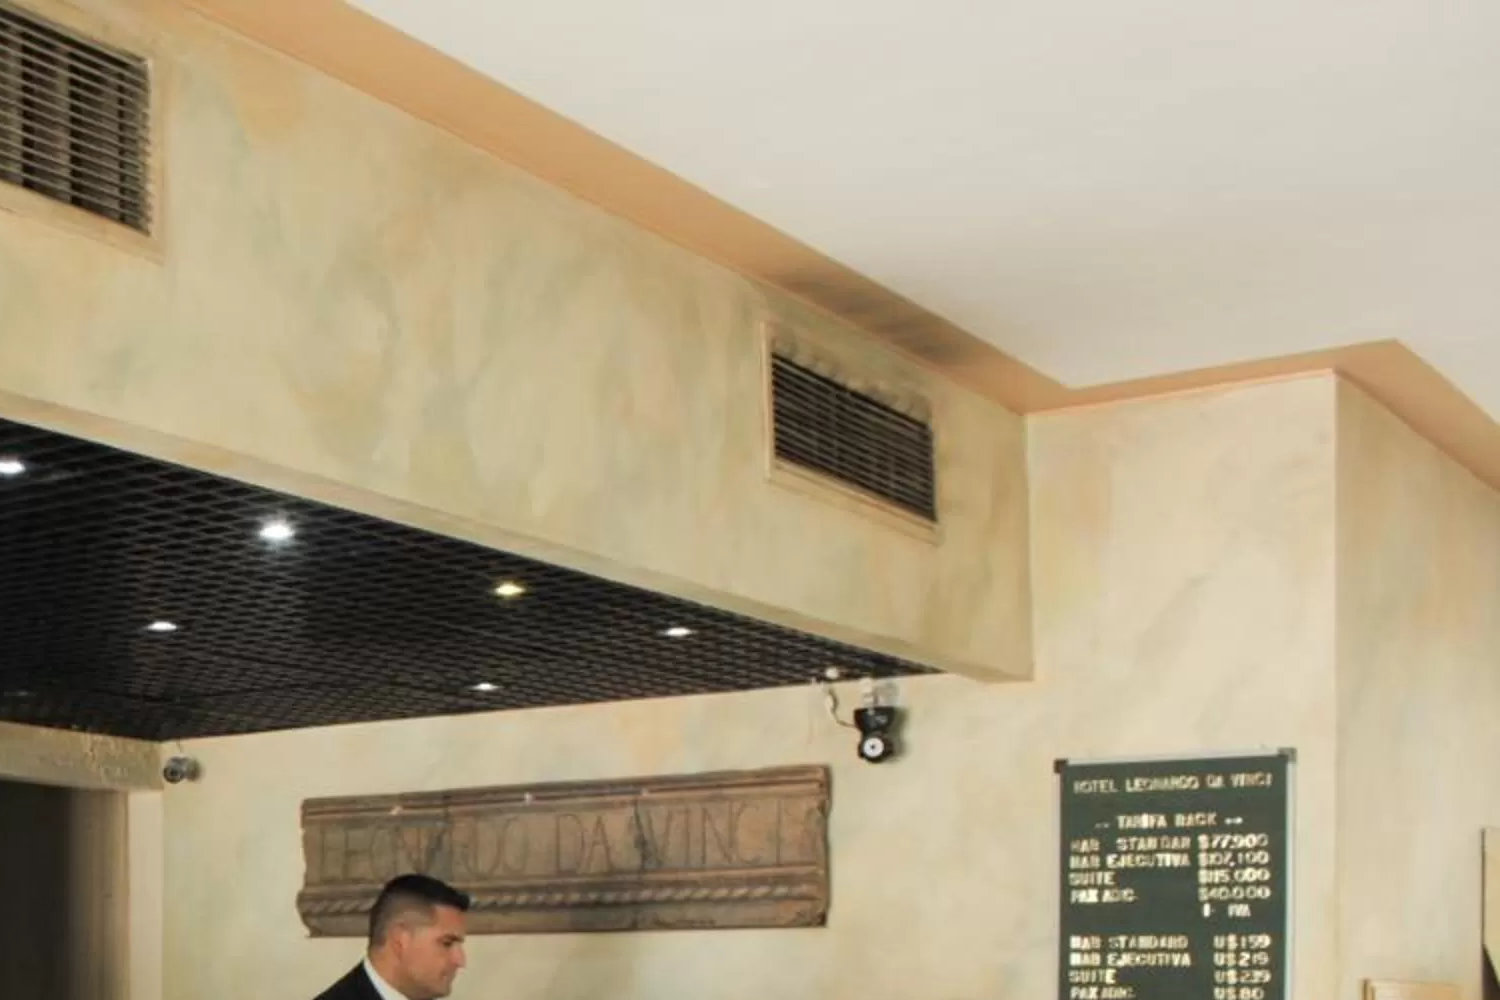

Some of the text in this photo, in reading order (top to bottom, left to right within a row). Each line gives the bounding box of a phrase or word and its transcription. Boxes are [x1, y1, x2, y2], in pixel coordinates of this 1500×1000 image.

[1074, 780, 1117, 793] HOTEL
[555, 813, 614, 874] DA
[644, 799, 783, 867] VINCI
[1069, 871, 1115, 885] SUITE
[1069, 968, 1116, 984] SUITE
